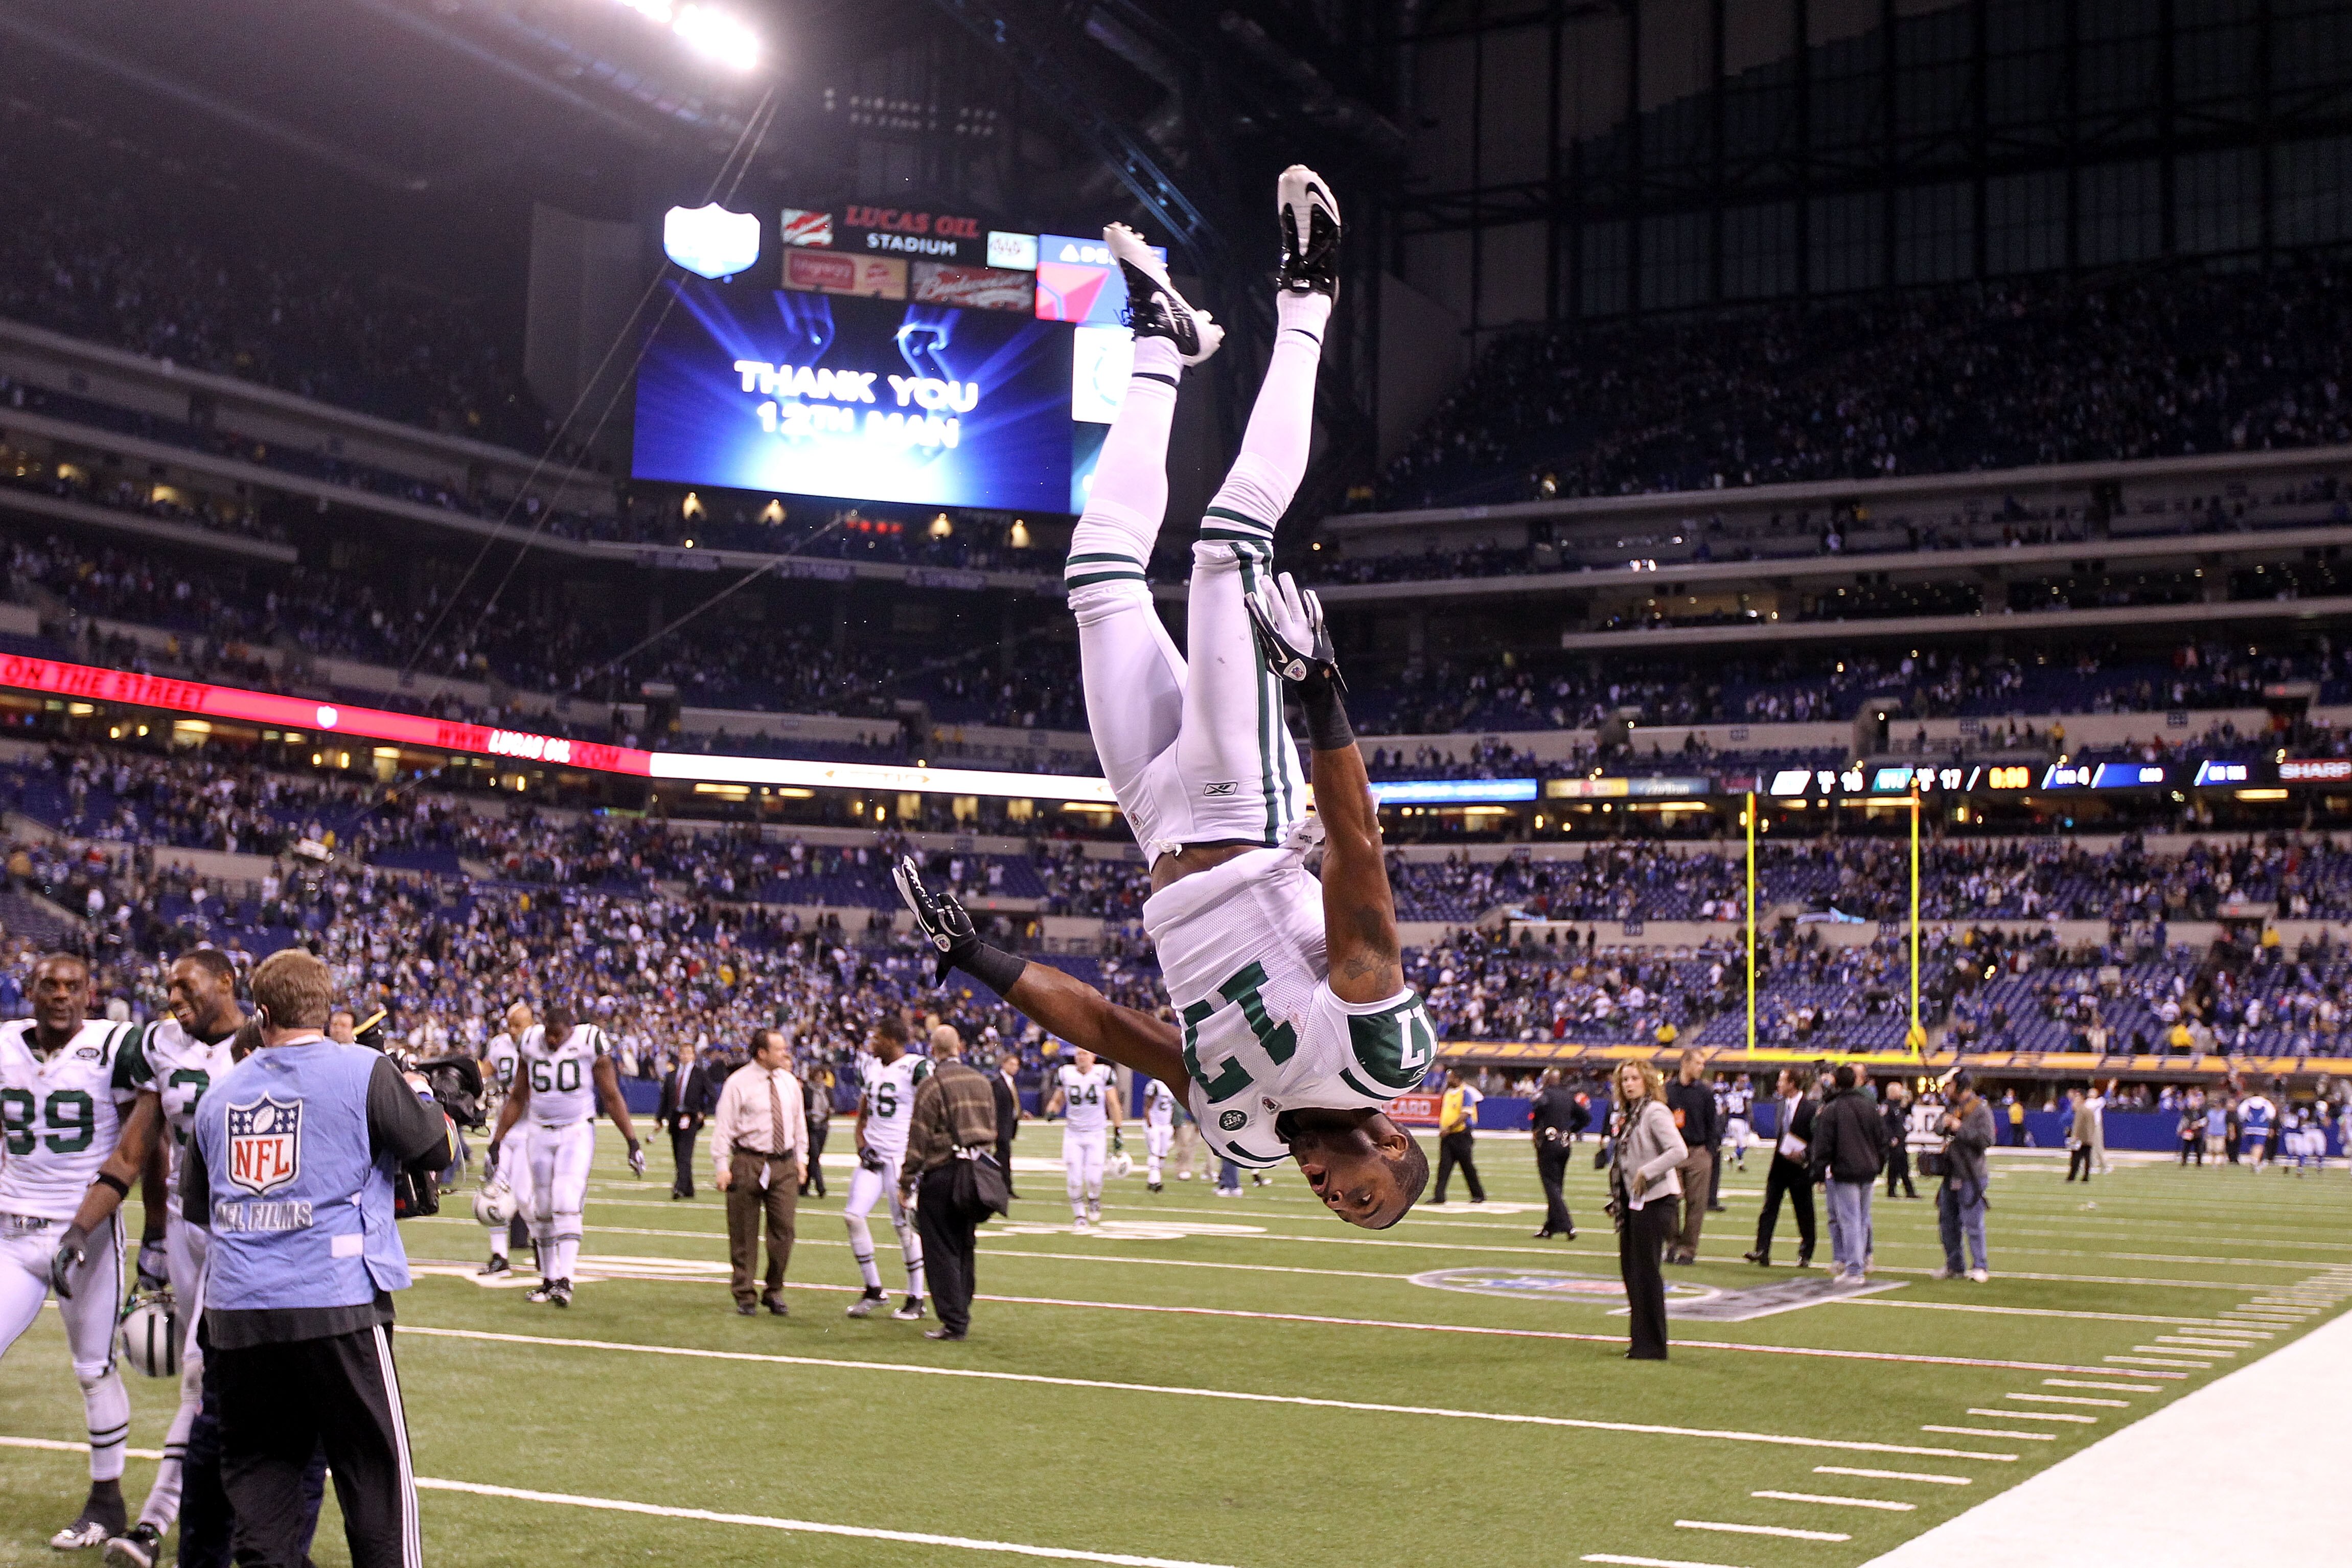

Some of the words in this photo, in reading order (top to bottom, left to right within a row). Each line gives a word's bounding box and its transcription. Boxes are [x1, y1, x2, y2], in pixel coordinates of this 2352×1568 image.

[845, 205, 930, 234] LUCAS
[934, 216, 979, 239] OIL
[866, 232, 957, 256] STADIUM
[734, 360, 877, 404] THANK
[888, 374, 979, 413] YOU
[757, 401, 854, 436] 12TH
[867, 410, 959, 449] MAN
[1940, 769, 1962, 790] 17
[1989, 767, 2029, 789] 0:00
[2279, 762, 2352, 780] SHARP
[1182, 960, 1297, 1104] 17
[1394, 1003, 1438, 1070] 17
[532, 1058, 580, 1092] 60
[0, 1089, 95, 1154] 89
[235, 1139, 289, 1183] NFL
[248, 1201, 313, 1231] FILMS
